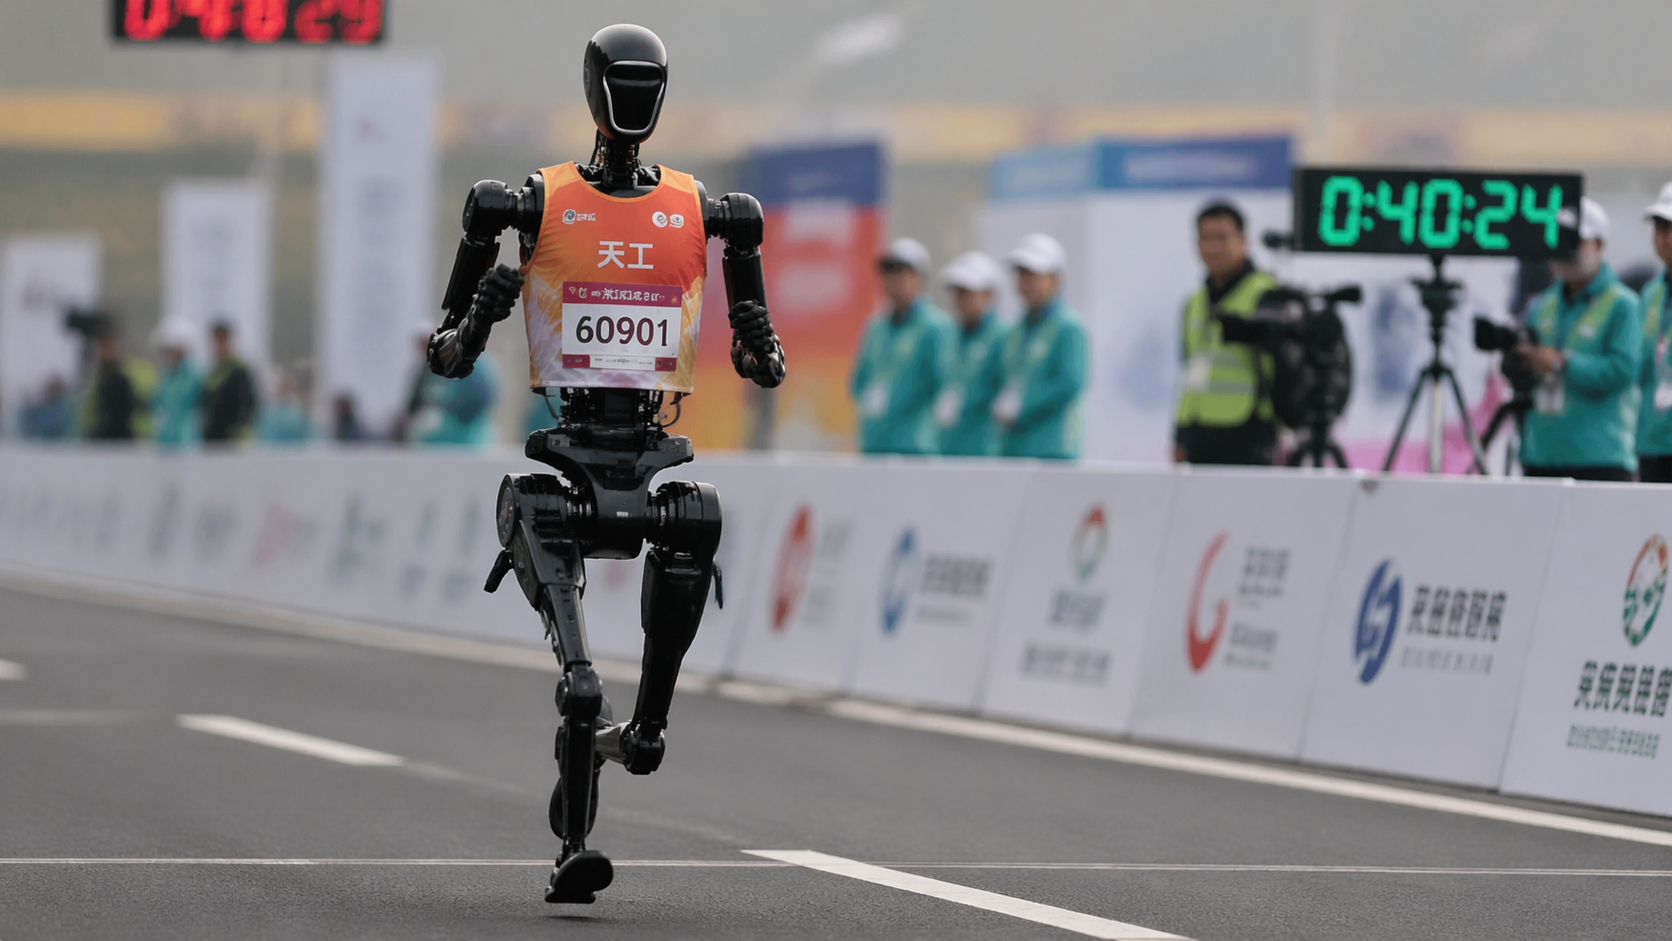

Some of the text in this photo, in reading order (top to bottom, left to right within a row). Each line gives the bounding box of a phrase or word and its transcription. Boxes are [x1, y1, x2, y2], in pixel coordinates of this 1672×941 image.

[1317, 174, 1563, 250] 0:40:24
[596, 240, 654, 270] 天工
[575, 315, 668, 347] 60901
